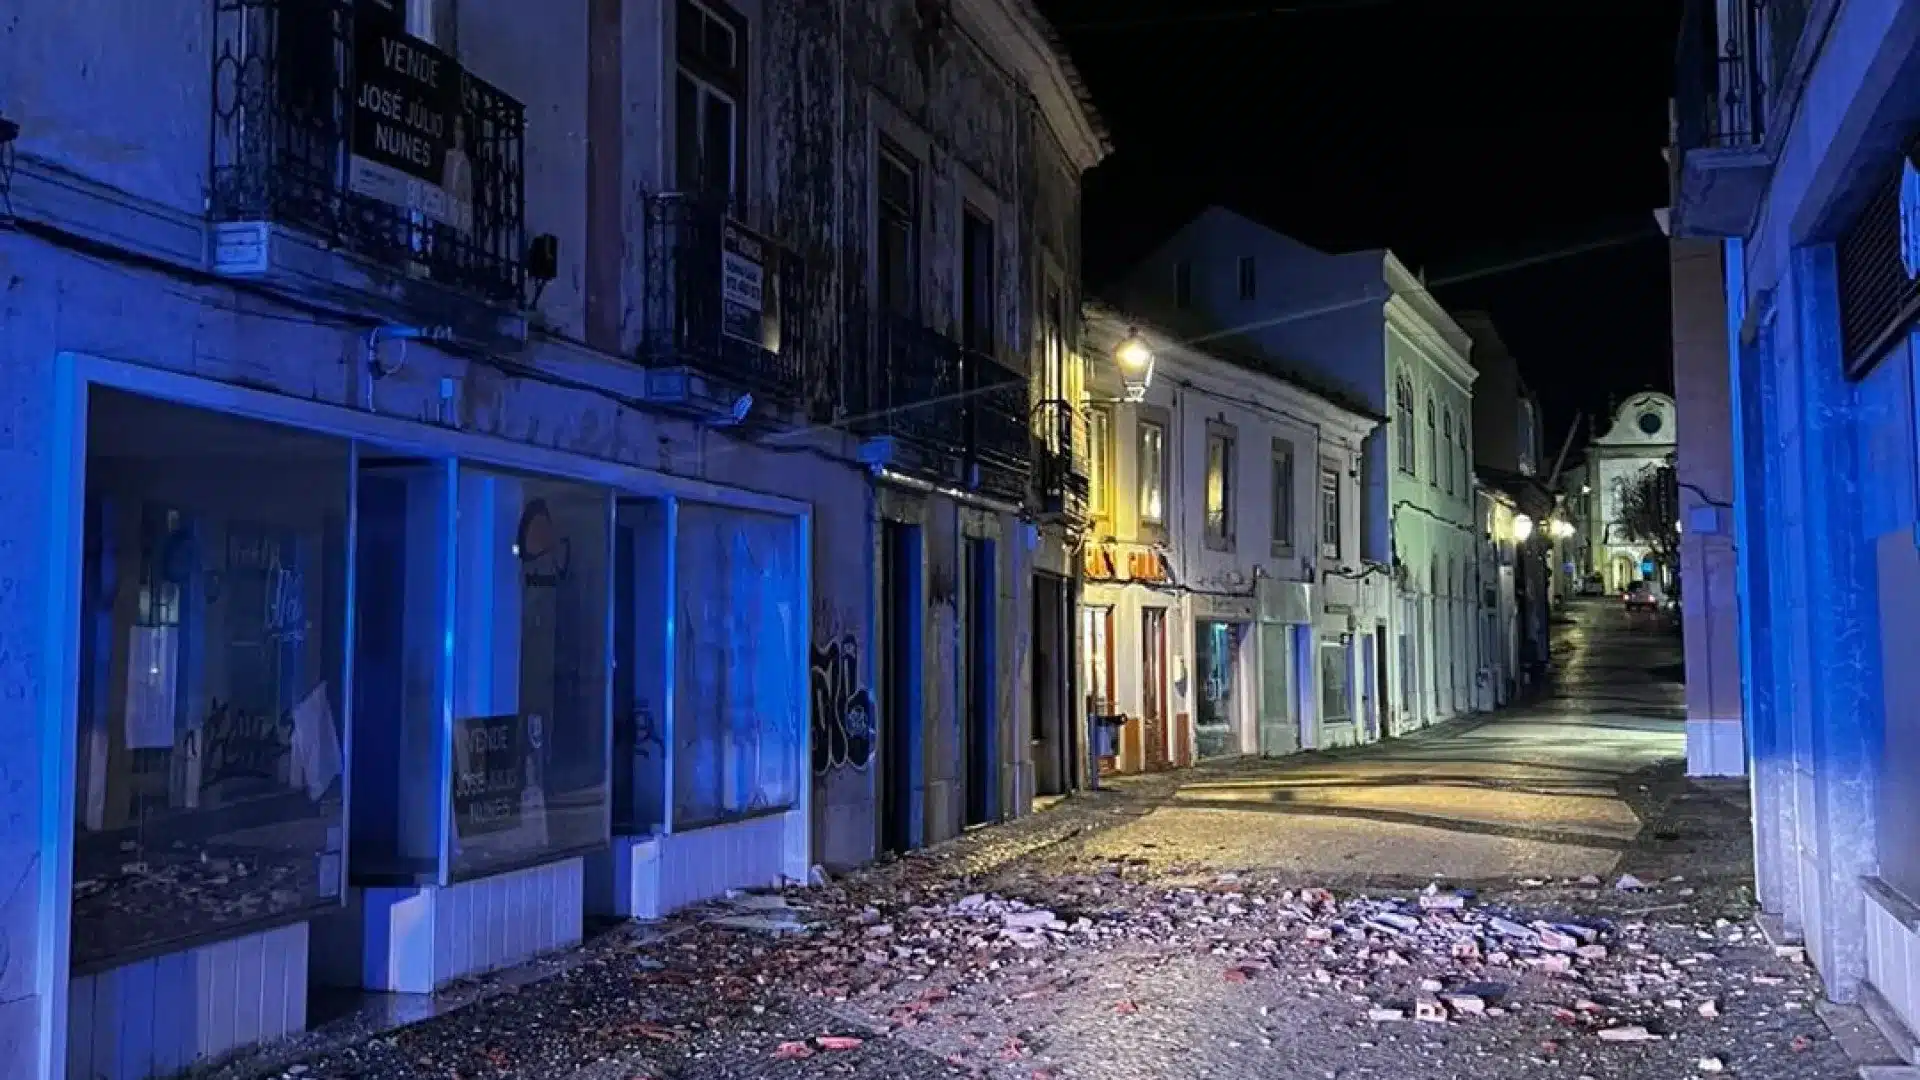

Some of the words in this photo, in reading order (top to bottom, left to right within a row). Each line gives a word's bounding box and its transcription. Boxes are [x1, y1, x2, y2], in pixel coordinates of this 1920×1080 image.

[381, 36, 441, 88] VENDE
[358, 81, 404, 122] JOSÉ
[404, 95, 444, 139] JÚLIO
[375, 121, 432, 168] NUNES
